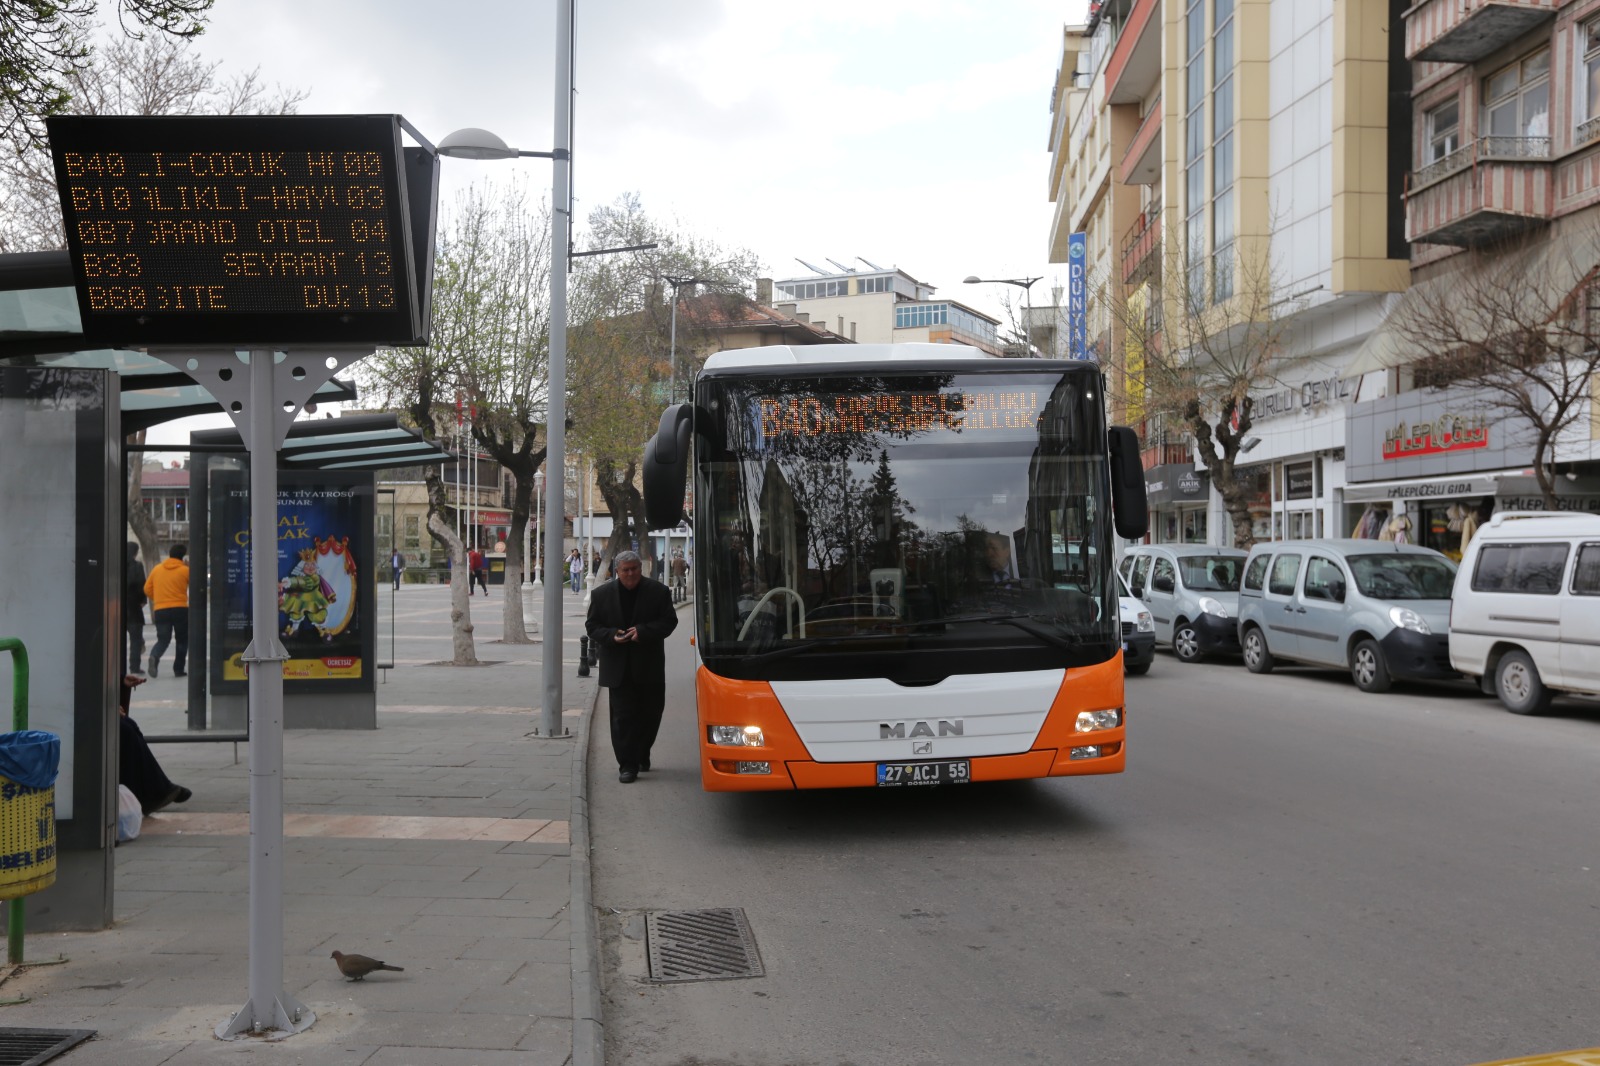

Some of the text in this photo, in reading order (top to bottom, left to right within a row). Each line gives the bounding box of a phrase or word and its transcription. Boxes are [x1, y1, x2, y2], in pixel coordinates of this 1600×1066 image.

[65, 152, 125, 177] B40
[344, 152, 380, 175] 00
[71, 186, 132, 210] B10
[347, 185, 384, 209] 03
[257, 219, 334, 243] OTEL
[351, 219, 388, 242] 04
[82, 252, 391, 277] B33 SEYRAN 13
[88, 286, 146, 309] B60
[357, 284, 394, 308] 13
[761, 398, 821, 437] B40
[1447, 483, 1473, 494] GIDA
[879, 719, 964, 739] MAN
[885, 762, 966, 781] 27 ACJ 55
